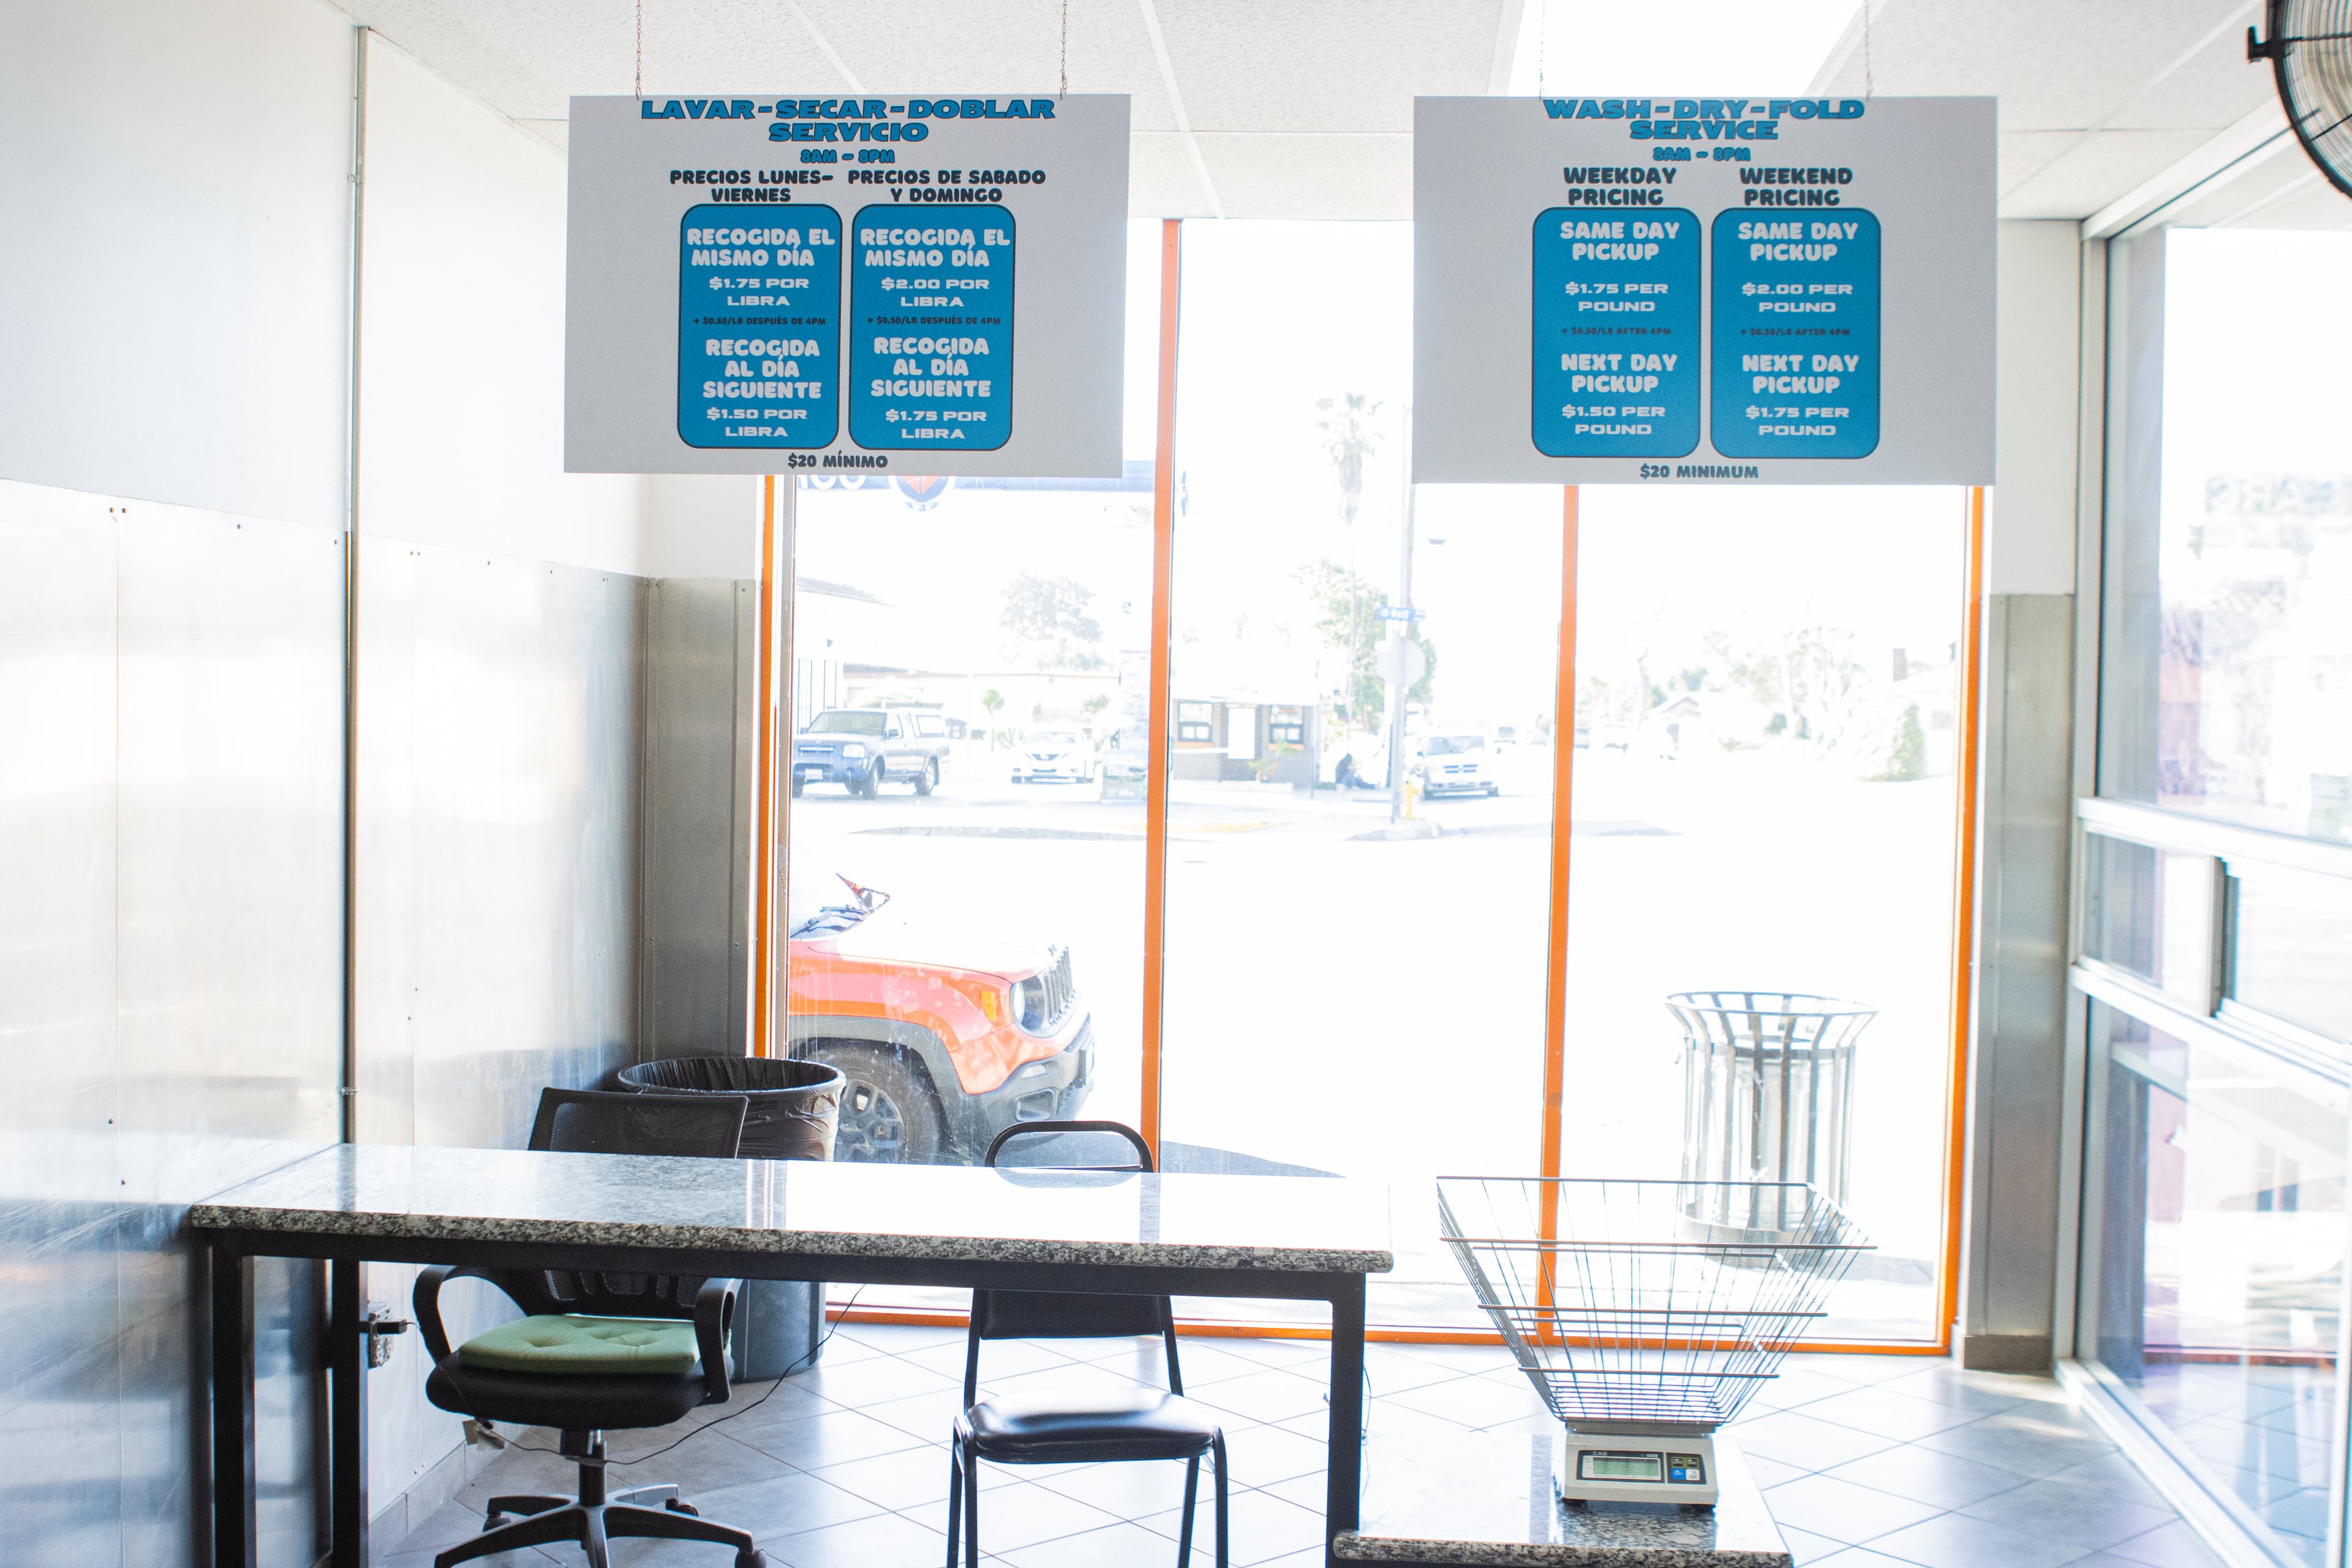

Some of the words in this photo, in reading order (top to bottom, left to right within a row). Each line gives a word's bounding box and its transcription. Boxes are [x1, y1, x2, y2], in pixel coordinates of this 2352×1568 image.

[769, 123, 929, 142] SERVICIO
[1630, 120, 1779, 140] SERVICE
[800, 149, 837, 164] 8AM
[858, 149, 895, 164] 8PM
[1653, 147, 1691, 161] 8AM
[1713, 147, 1751, 161] 8PM
[670, 170, 751, 184] PRECIOS
[759, 170, 833, 184] LUNES-
[848, 170, 930, 184] PRECIOS
[938, 170, 961, 184] DE
[968, 170, 1046, 184] SABADO
[1564, 167, 1676, 184] WEEKDAY
[1740, 167, 1853, 184] WEEKEND
[710, 187, 791, 202] VIERNES
[891, 187, 903, 202] Y
[908, 187, 1002, 202] DOMINGO
[1568, 188, 1664, 206] PRICING
[1744, 189, 1842, 206] PRICING
[687, 228, 801, 246] RECOGIDA
[809, 229, 835, 244] EL
[861, 228, 975, 246] RECOGIDA
[984, 229, 1010, 245] EL
[1561, 222, 1624, 238] SAME
[1634, 222, 1679, 239] DAY
[1739, 222, 1803, 239] SAME
[1812, 222, 1858, 239] DAY
[692, 249, 768, 266] MISMO
[776, 244, 815, 266] DÍA
[865, 250, 943, 266] MISMO
[951, 244, 990, 266] DÍA
[1573, 243, 1659, 260] PICKUP
[1751, 244, 1837, 260] PICKUP
[709, 277, 760, 290] $1.75
[766, 279, 809, 288] POR
[881, 277, 940, 290] $2.00
[946, 279, 989, 288] POR
[1566, 282, 1618, 295] $1.75
[1625, 284, 1668, 293] PER
[1743, 282, 1803, 296] $2.00
[1809, 285, 1852, 294] PER
[728, 296, 790, 305] LIBRA
[901, 297, 963, 306] LIBRA
[1579, 301, 1655, 311] POUND
[1760, 303, 1836, 312] POUND
[703, 316, 743, 325] $0.50/LB
[746, 315, 788, 325] DESPUÉS
[876, 315, 917, 325] $0.50/LB
[921, 315, 962, 324] DESPUÉS
[706, 339, 820, 356] RECOGIDA
[874, 337, 989, 355] RECOGIDA
[725, 361, 754, 377] AL
[762, 355, 800, 377] DÍA
[894, 359, 922, 376] AL
[931, 353, 969, 376] DÍA
[1562, 354, 1622, 371] NEXT
[1631, 354, 1677, 371] DAY
[1743, 355, 1803, 371] NEXT
[1813, 355, 1859, 372] DAY
[703, 381, 821, 398] SIGUIENTE
[871, 380, 990, 397] SIGUIENTE
[1572, 375, 1658, 393] PICKUP
[1753, 376, 1840, 393] PICKUP
[707, 407, 758, 420] $1.50
[764, 410, 807, 419] POR
[886, 409, 937, 422] $1.75
[943, 412, 986, 421] POR
[1562, 404, 1616, 418] $1.50
[1622, 407, 1665, 417] PER
[1746, 405, 1800, 419] $1.75
[1806, 408, 1849, 417] PER
[725, 427, 788, 436] LIBRA
[902, 429, 965, 439] LIBRA
[1575, 424, 1651, 434] POUND
[1759, 425, 1836, 435] POUND
[788, 453, 816, 469] $20
[822, 450, 888, 467] MÍNIMO
[1641, 463, 1670, 479] $20
[1677, 466, 1758, 478] MINIMUM
